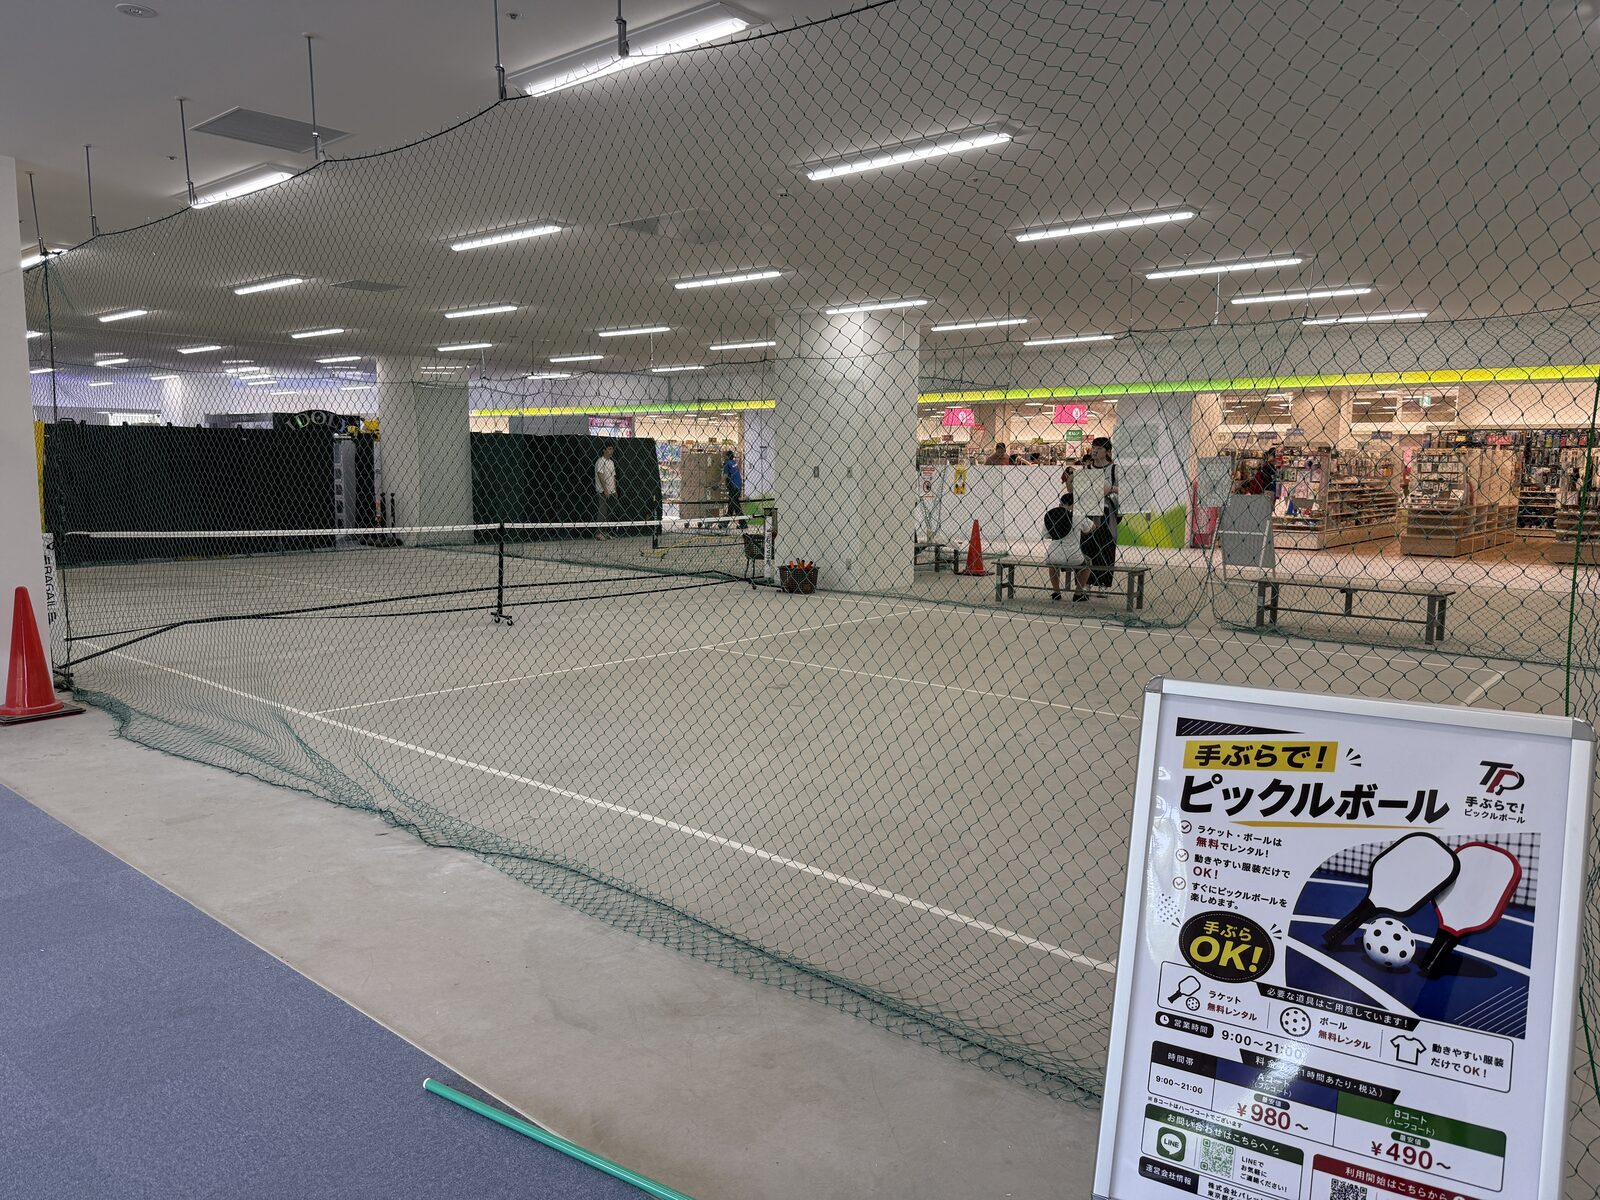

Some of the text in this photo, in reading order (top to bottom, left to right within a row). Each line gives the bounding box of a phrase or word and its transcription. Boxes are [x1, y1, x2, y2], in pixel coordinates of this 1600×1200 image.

[1194, 743, 1328, 769] 手ぶらで！
[1180, 773, 1450, 824] ピックルボール
[1465, 796, 1525, 814] 手ぶらで！
[1464, 808, 1526, 824] ピックルボール
[1197, 825, 1283, 847] ラケット・ボールは
[1195, 836, 1269, 858] 無料でレンタル！
[1194, 854, 1291, 879] 動きやすい服装だけで
[1190, 892, 1240, 910] 楽しめます。
[1191, 882, 1288, 908] すぐにピックルボールを
[1203, 920, 1252, 941] 手ぶら
[1189, 935, 1264, 973] OK!
[1208, 990, 1241, 1004] ラケット
[1206, 1002, 1258, 1021] 無料レンタル
[1266, 987, 1409, 1028] 必要な道具はご用意しています！
[1173, 1018, 1209, 1035] 営業時間
[1319, 1016, 1348, 1031] ボール
[1317, 1029, 1372, 1051] 無料レンタル
[1167, 1052, 1195, 1066] 時間帯
[1431, 1043, 1505, 1068] 動きやすい服装
[1155, 1075, 1203, 1094] 9:00～21:00
[1394, 1109, 1428, 1124] Bコート
[1166, 1113, 1269, 1151] お問い合わせはこちらへ
[1399, 1133, 1423, 1147] 最安値
[1163, 1138, 1180, 1149] LINE
[1240, 1165, 1268, 1178] お気軽に
[1241, 1156, 1265, 1168] LINEで
[1145, 1163, 1192, 1186] 運営会社情報
[1345, 1166, 1448, 1200] 利用開始はこちらから
